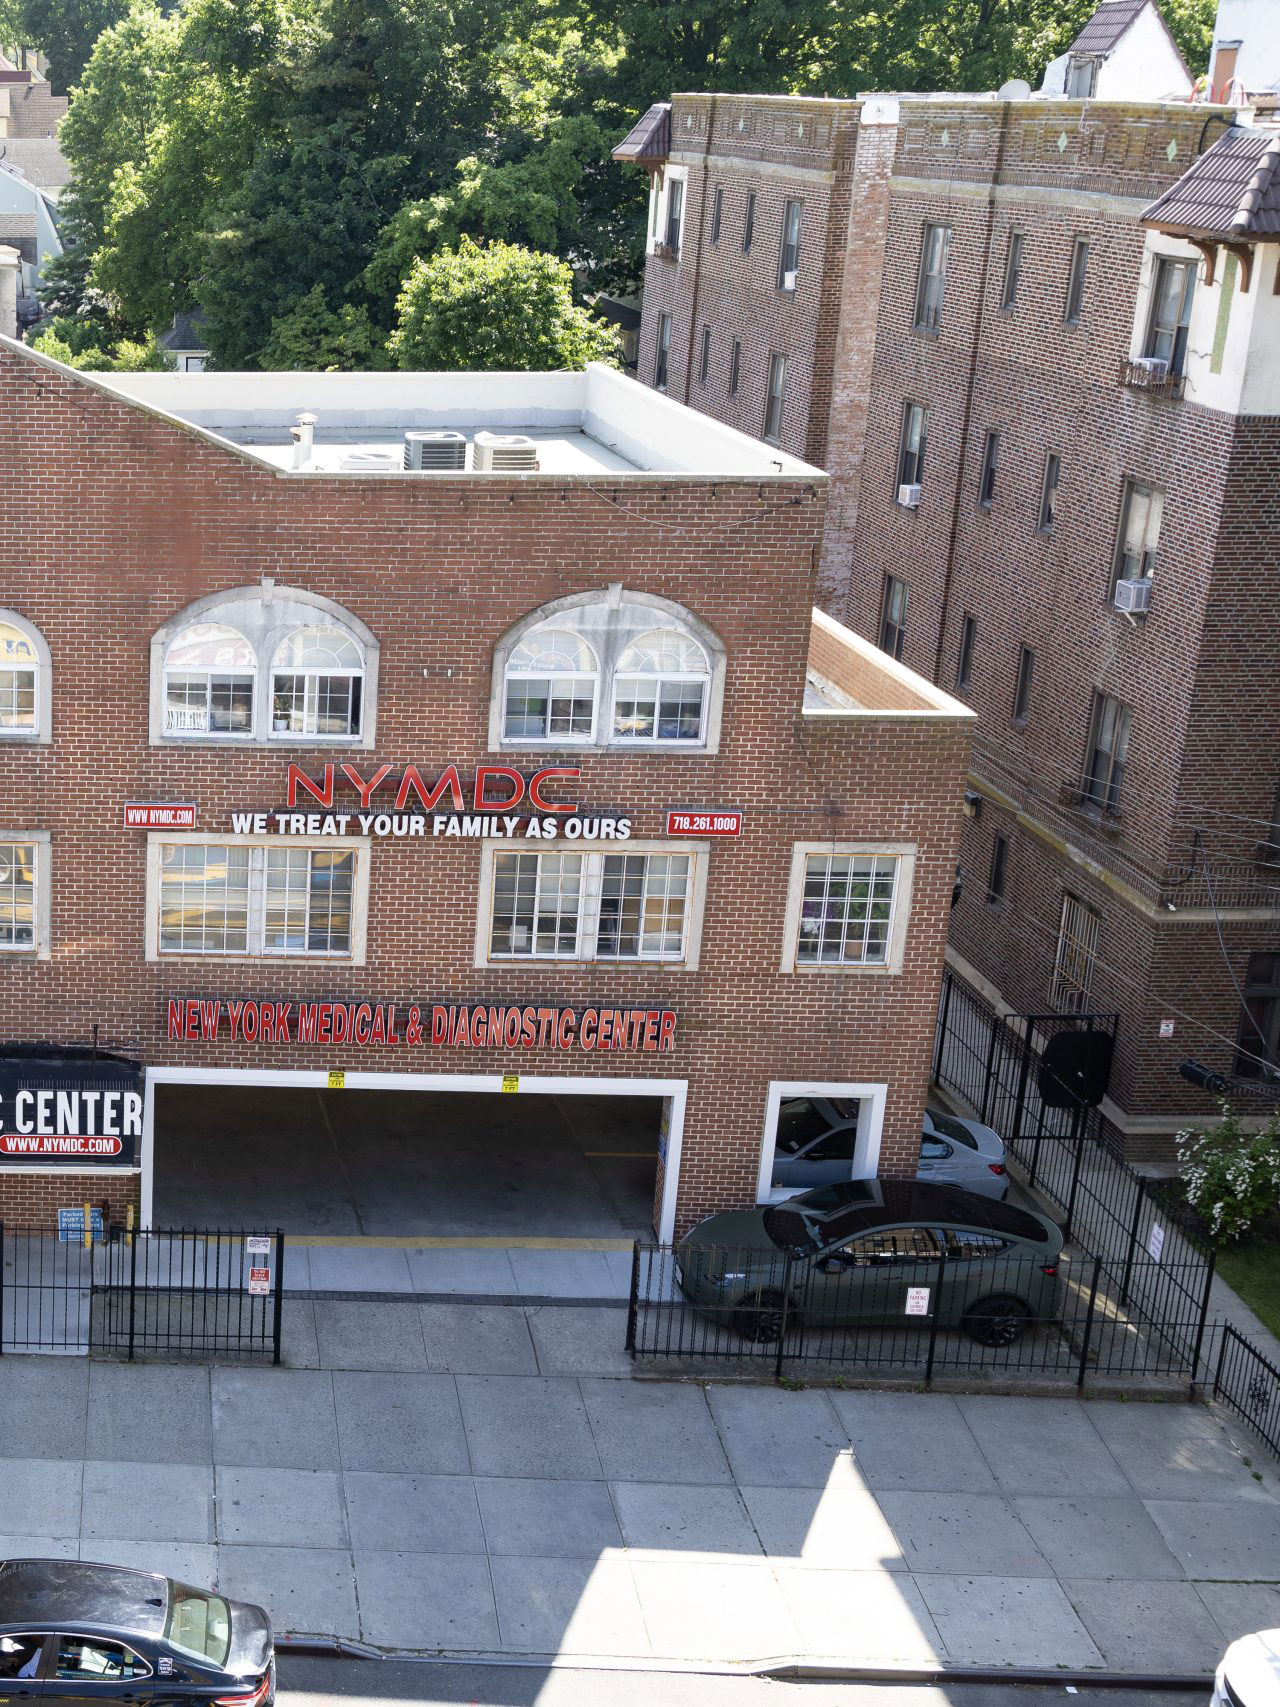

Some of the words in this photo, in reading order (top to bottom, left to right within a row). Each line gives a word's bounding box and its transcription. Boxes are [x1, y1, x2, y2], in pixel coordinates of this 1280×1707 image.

[287, 763, 581, 813] NYMDC
[149, 809, 193, 825] NYMDC.COM
[231, 813, 267, 834] WE
[275, 813, 351, 836] TREAT
[358, 814, 425, 837] YOUR
[433, 815, 522, 838] FAMILY
[525, 817, 558, 839] AS
[564, 818, 632, 841] OURS
[673, 817, 737, 831] 718.261.1000
[168, 1000, 220, 1040] NEW
[227, 1000, 291, 1042] YORK
[297, 1003, 399, 1045] MEDICAL
[406, 1004, 423, 1045] &
[431, 1005, 576, 1049] DIAGNOSTIC
[580, 1008, 677, 1051] CENTER
[15, 1090, 142, 1136] CENTER
[6, 1137, 114, 1153] WWW.NYMDC.COM
